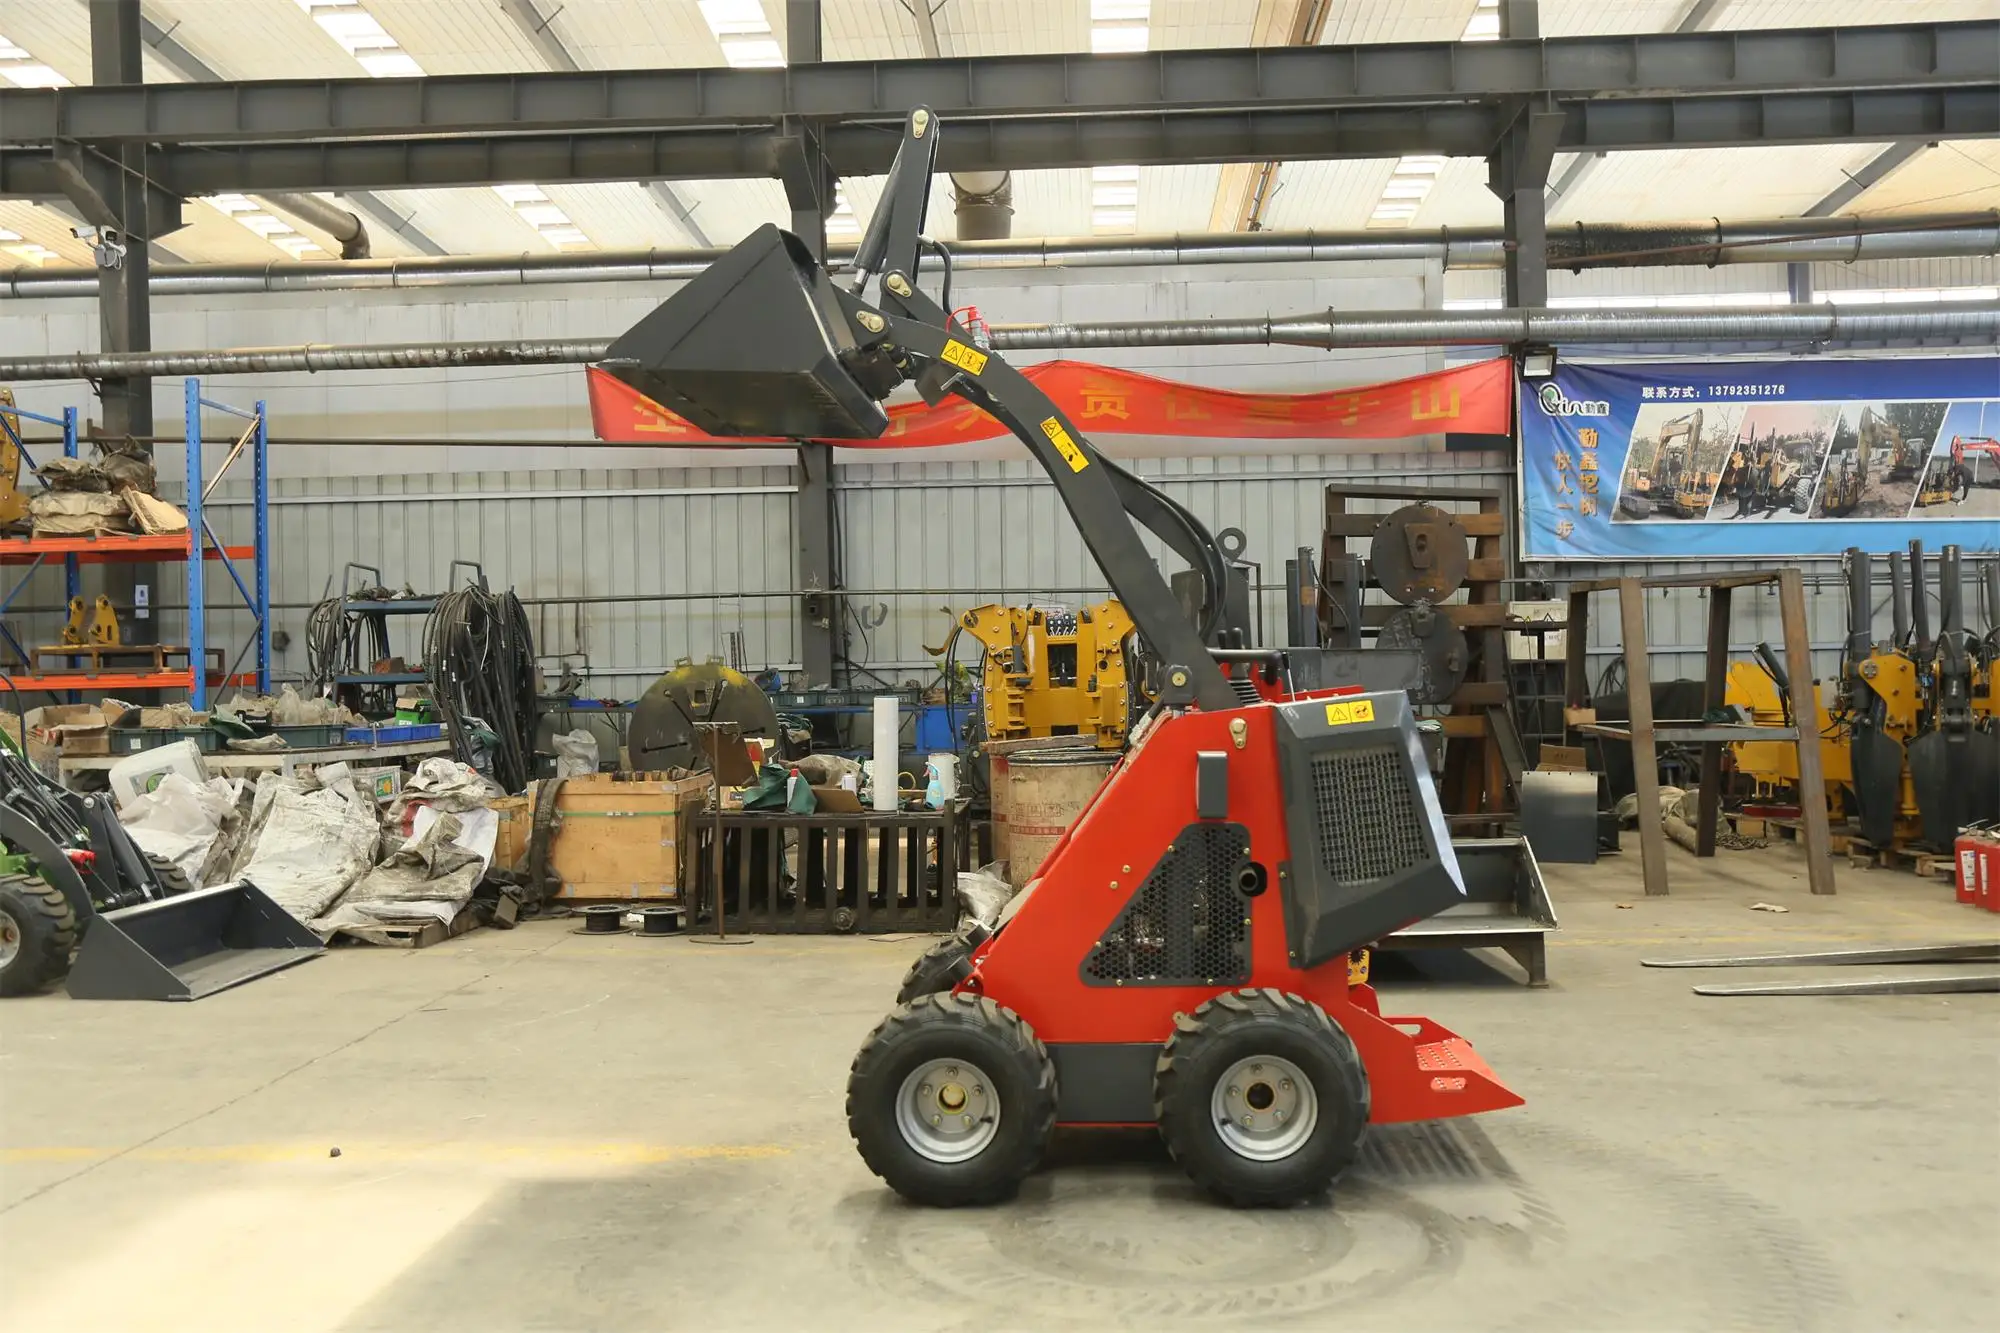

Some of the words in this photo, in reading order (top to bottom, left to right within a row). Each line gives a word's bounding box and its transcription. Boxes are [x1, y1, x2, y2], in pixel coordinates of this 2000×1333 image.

[1708, 384, 1785, 397] 13792351276
[1554, 451, 1574, 540] 快人一步
